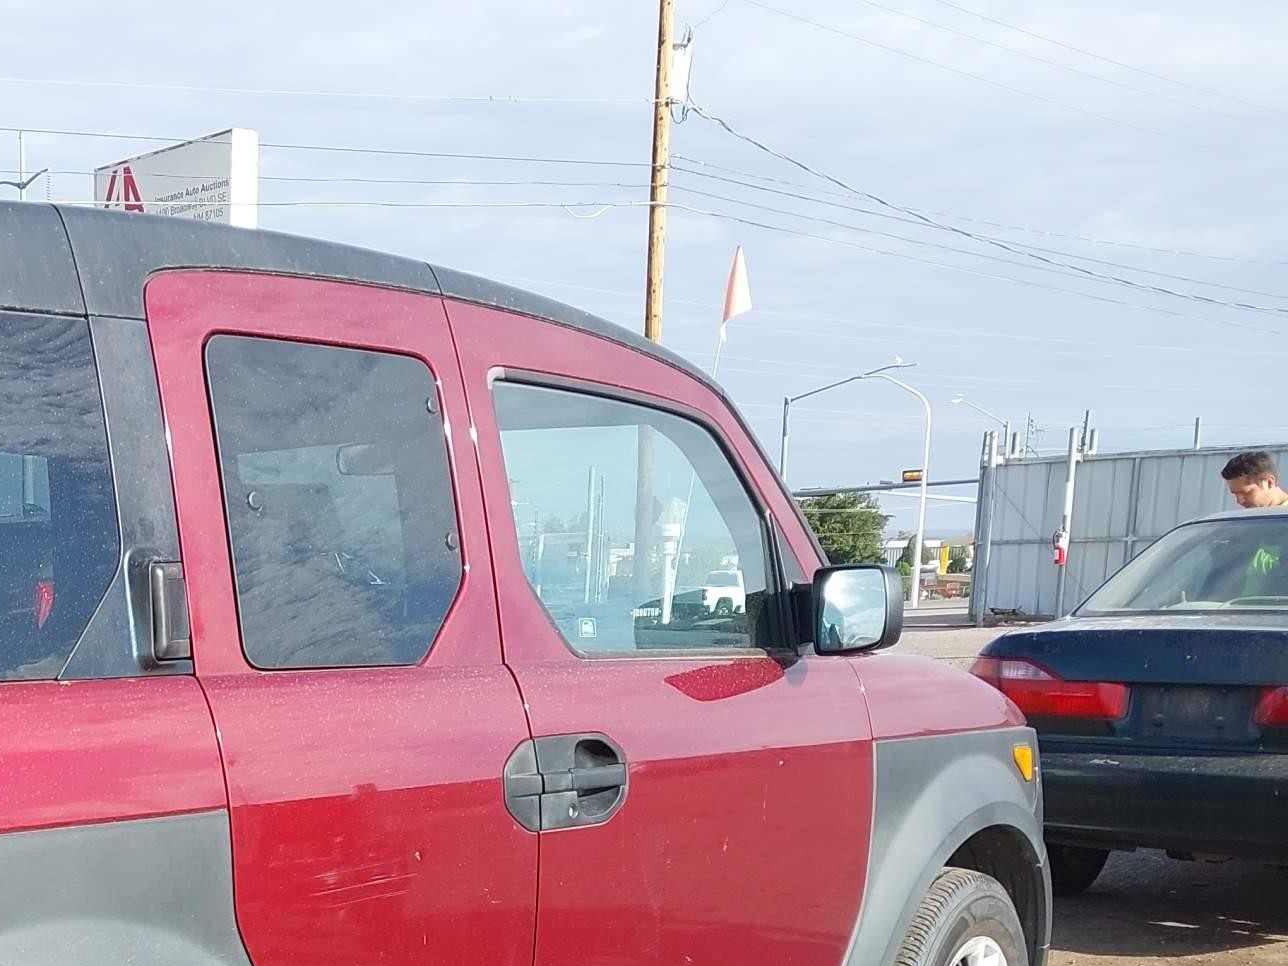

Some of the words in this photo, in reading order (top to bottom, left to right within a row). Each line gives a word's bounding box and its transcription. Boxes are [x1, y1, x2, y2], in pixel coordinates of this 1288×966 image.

[154, 191, 184, 202] Insurance
[185, 186, 200, 196] Auto
[200, 179, 230, 193] Auctions
[205, 207, 224, 221] 87105
